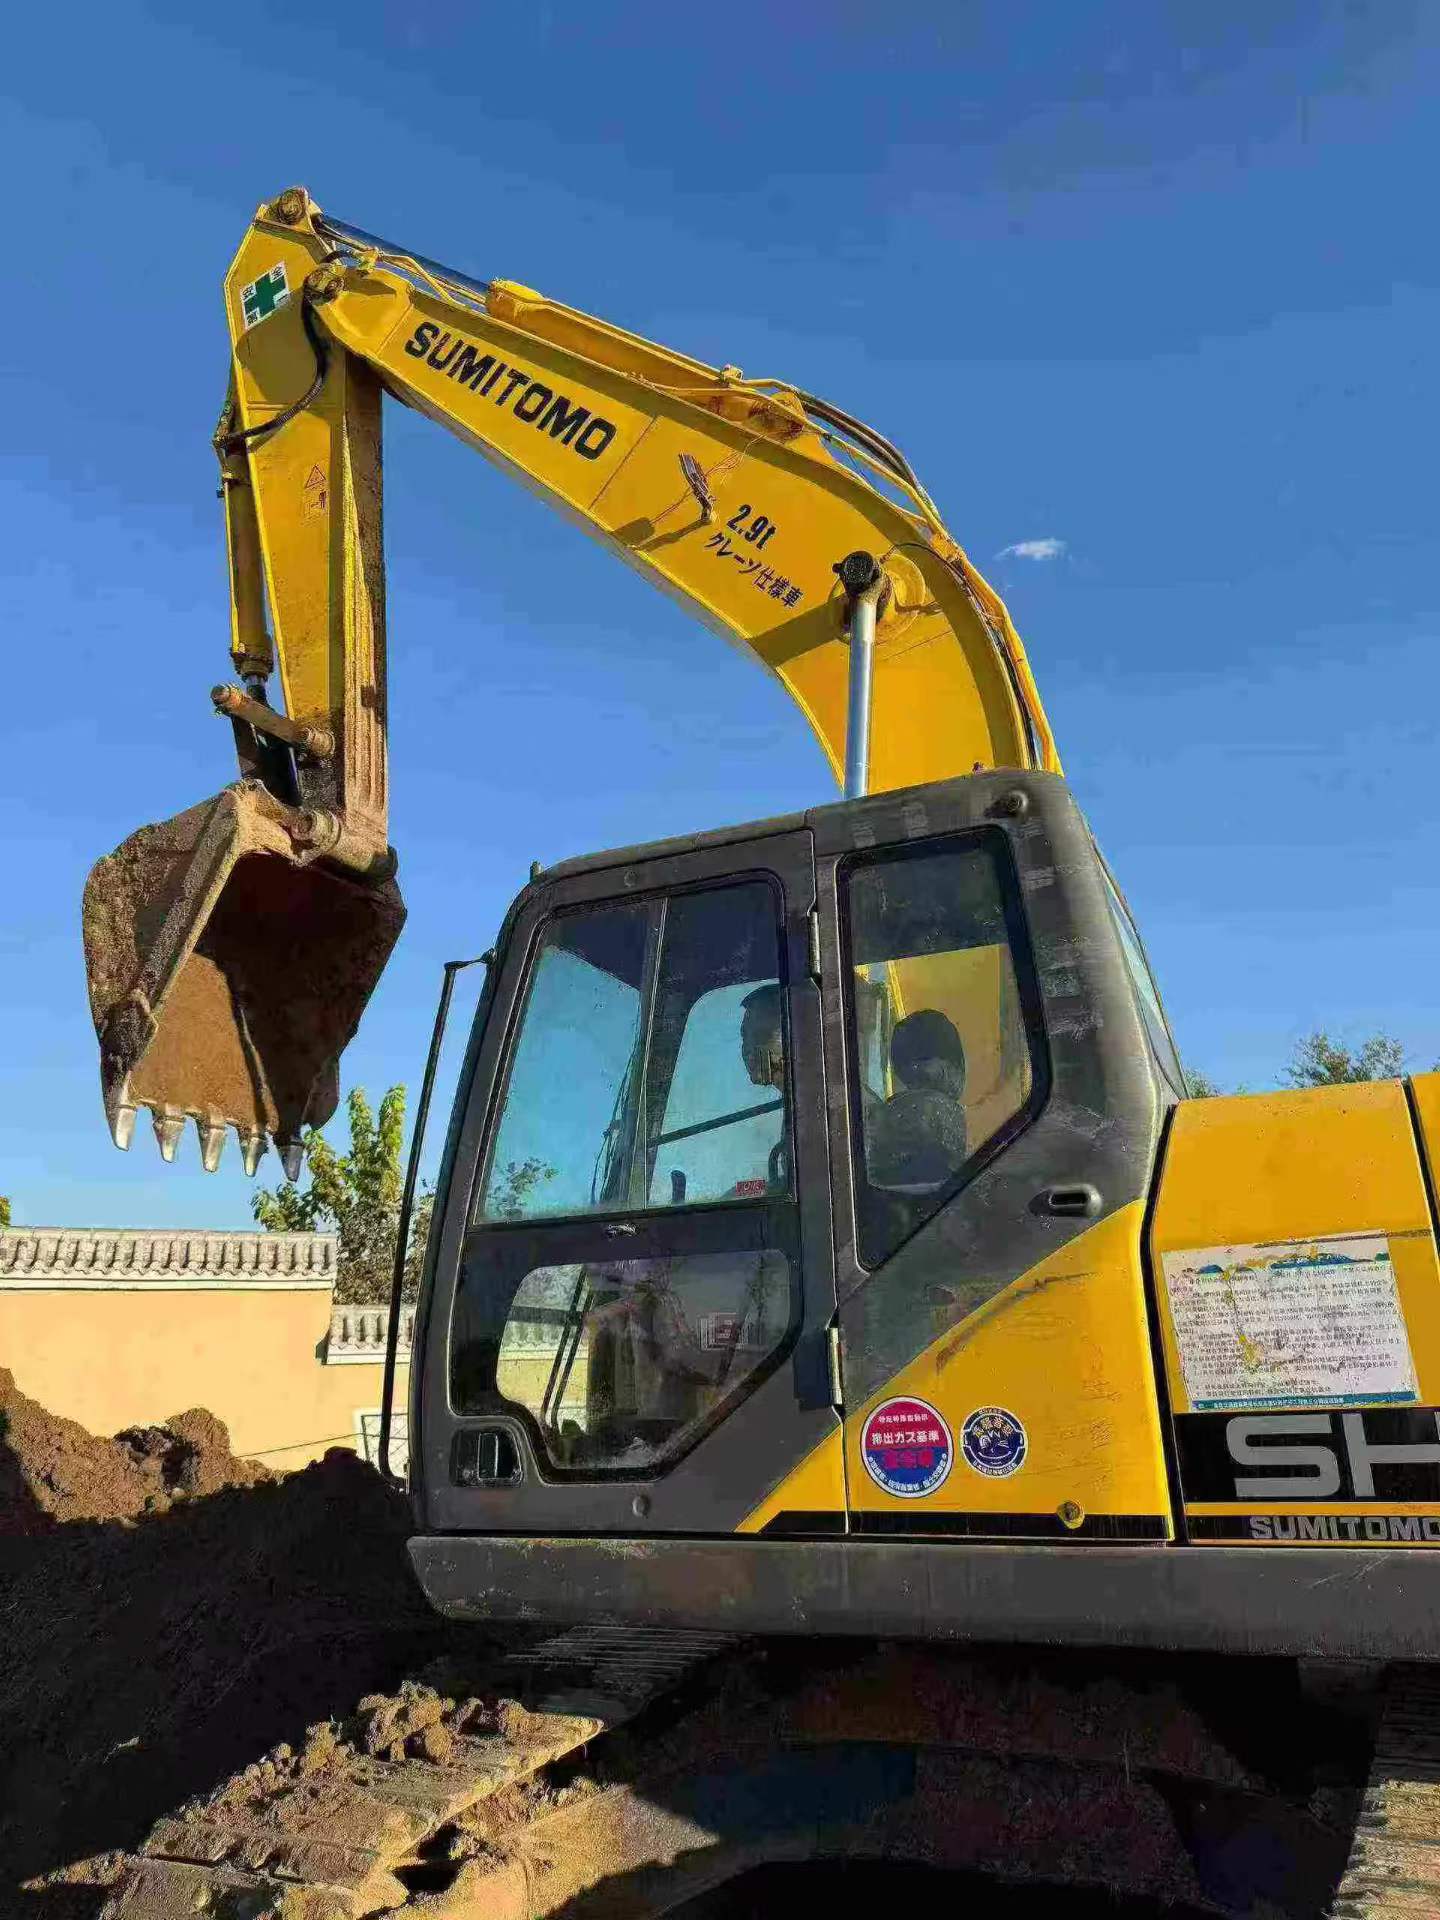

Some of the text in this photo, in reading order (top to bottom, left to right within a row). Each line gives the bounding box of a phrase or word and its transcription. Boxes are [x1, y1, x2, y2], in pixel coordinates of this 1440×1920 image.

[404, 321, 617, 460] SUMITOMO
[726, 504, 777, 549] 2.9t
[1226, 1412, 1440, 1497] SH
